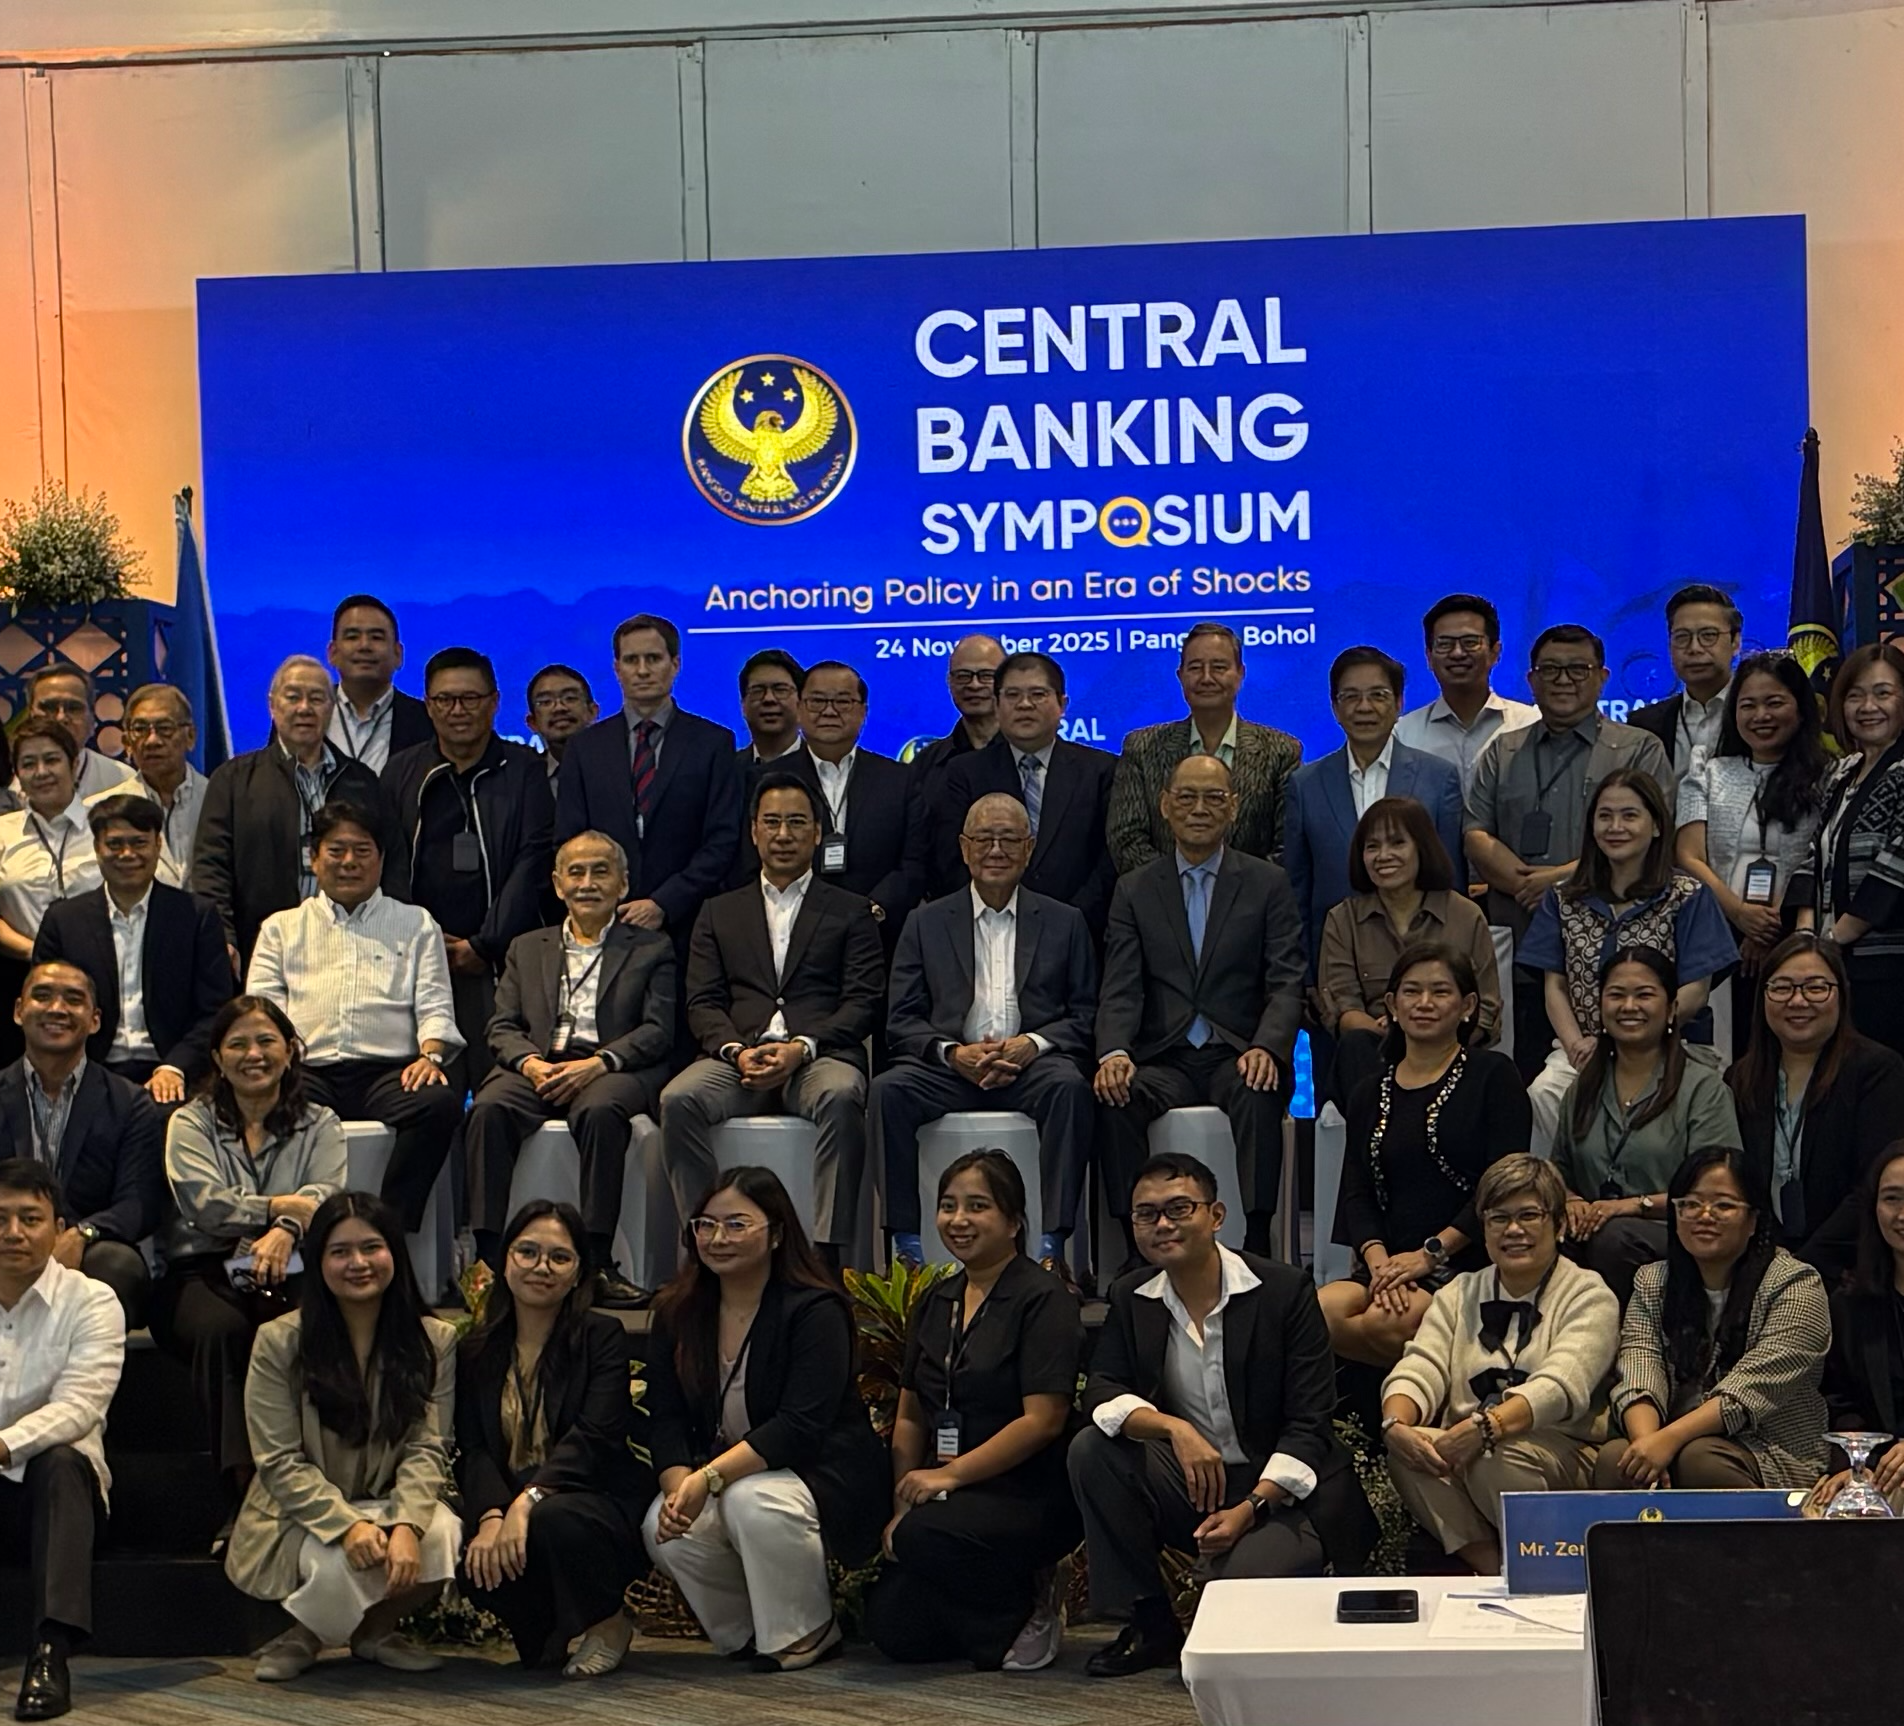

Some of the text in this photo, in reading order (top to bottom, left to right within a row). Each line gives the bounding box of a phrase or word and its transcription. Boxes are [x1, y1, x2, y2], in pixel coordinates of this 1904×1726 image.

[915, 296, 1307, 378] CENTRAL
[916, 393, 1309, 474] BANKING
[705, 565, 1311, 614] Anchoring Policy in an Era of Shocks
[875, 638, 906, 659] 24
[912, 634, 1043, 658] Novber
[1047, 631, 1110, 654] 2025
[1243, 624, 1316, 646] Bohol
[1520, 1542, 1550, 1556] Mr.
